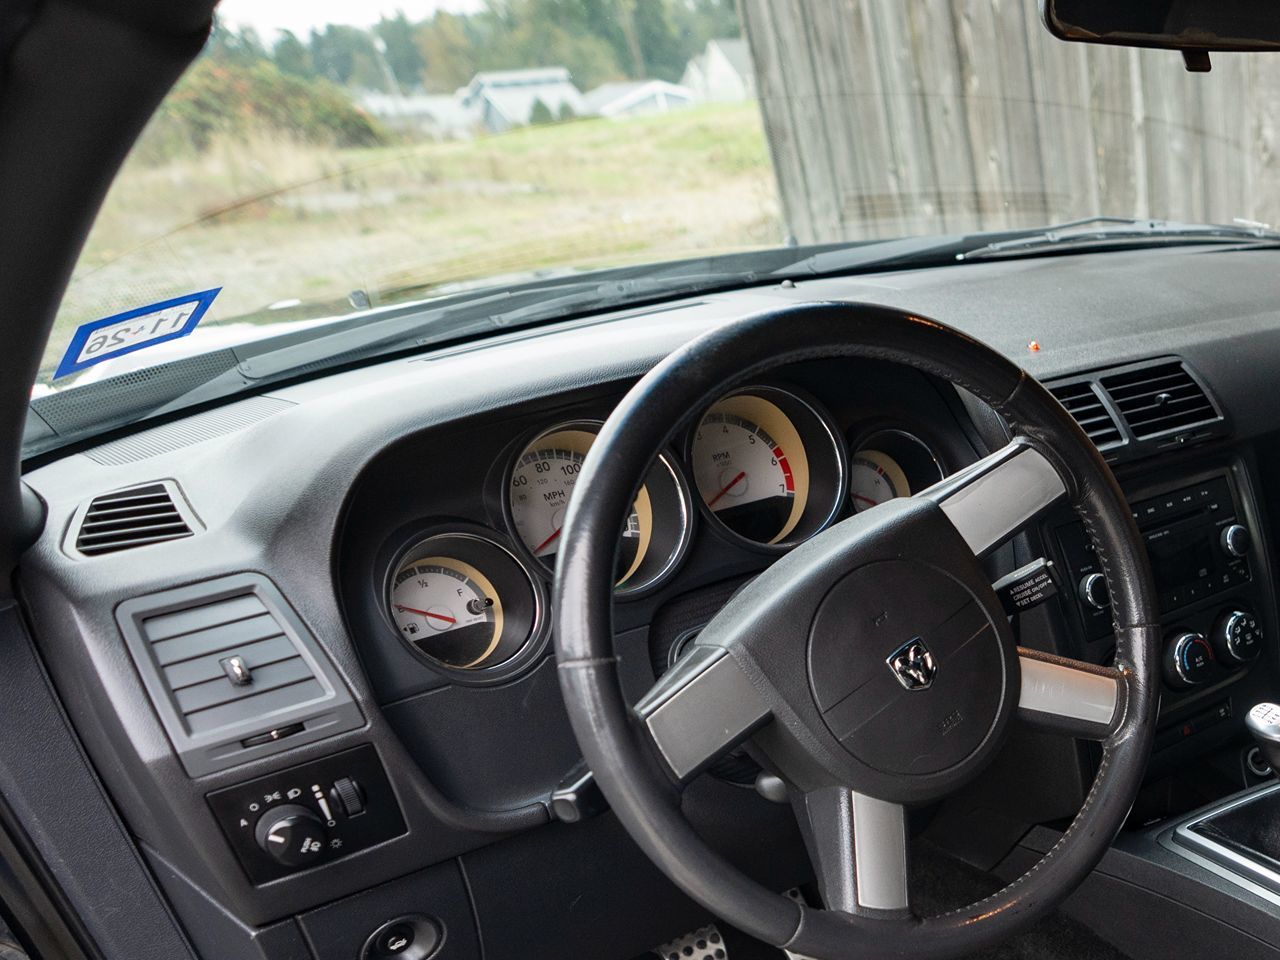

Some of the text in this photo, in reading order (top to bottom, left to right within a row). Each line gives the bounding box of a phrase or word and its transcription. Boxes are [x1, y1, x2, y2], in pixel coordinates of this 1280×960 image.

[722, 425, 729, 434] 4
[748, 434, 756, 445] 5
[712, 451, 731, 462] RPM
[771, 457, 778, 466] 6
[535, 461, 551, 474] 80
[561, 463, 581, 476] 100
[512, 475, 528, 488] 60
[779, 484, 785, 493] 7
[543, 490, 566, 502] MPH
[1013, 573, 1048, 593] RESUME ACCEL
[456, 588, 463, 597] F
[1013, 581, 1048, 601] CRUISE ON/OFF
[1020, 592, 1044, 607] SET DECEL
